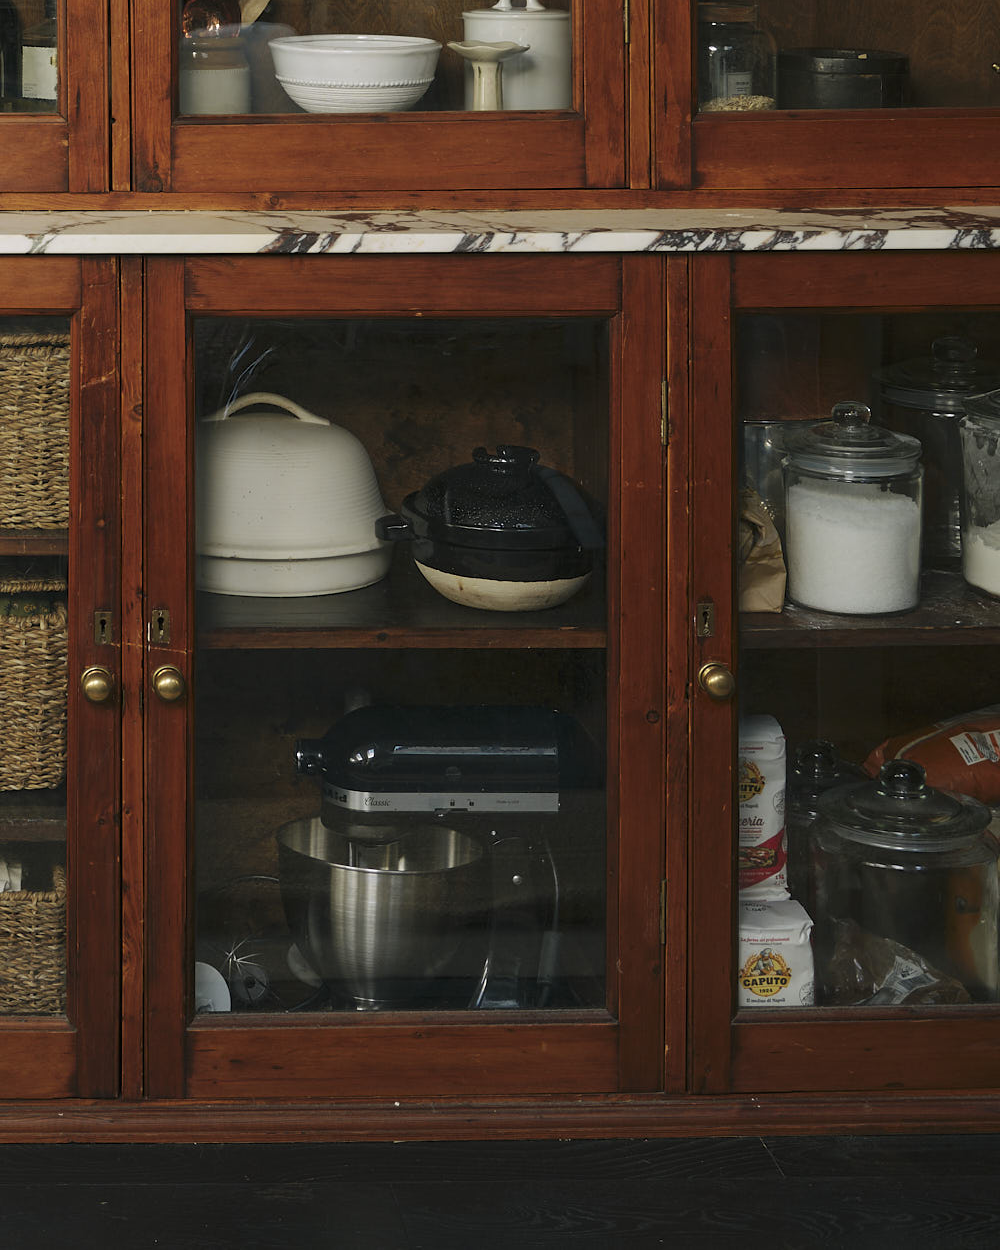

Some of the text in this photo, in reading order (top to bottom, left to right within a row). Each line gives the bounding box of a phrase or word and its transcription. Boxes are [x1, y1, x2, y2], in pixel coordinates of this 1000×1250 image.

[364, 796, 391, 807] Classic
[740, 816, 765, 826] eria
[743, 977, 788, 987] CAPUTO
